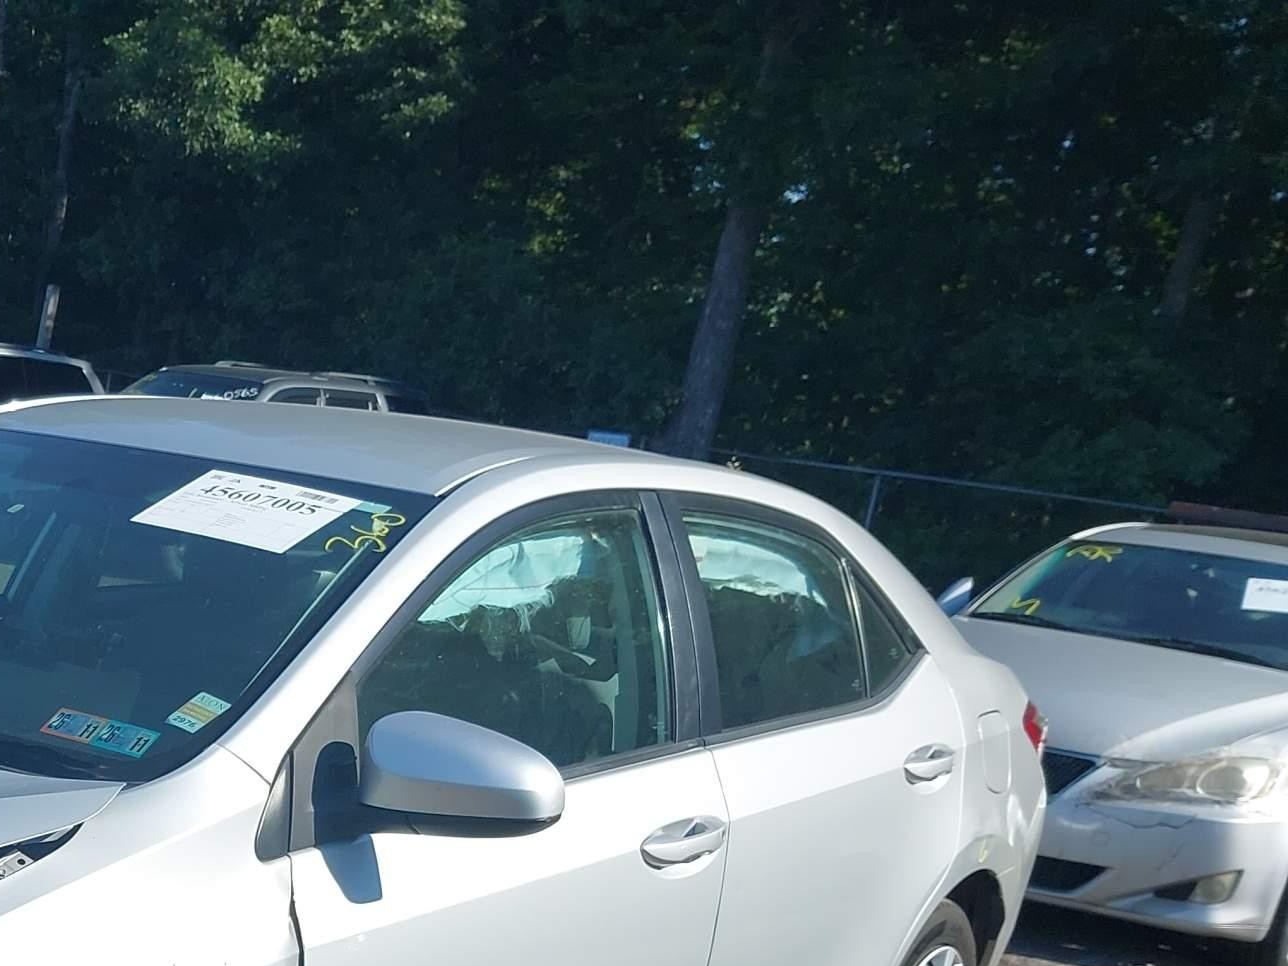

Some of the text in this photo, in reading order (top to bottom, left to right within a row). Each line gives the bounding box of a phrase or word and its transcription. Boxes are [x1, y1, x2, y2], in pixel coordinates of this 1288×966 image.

[200, 485, 323, 516] 45607005
[79, 723, 99, 739] 11
[129, 736, 151, 753] 11
